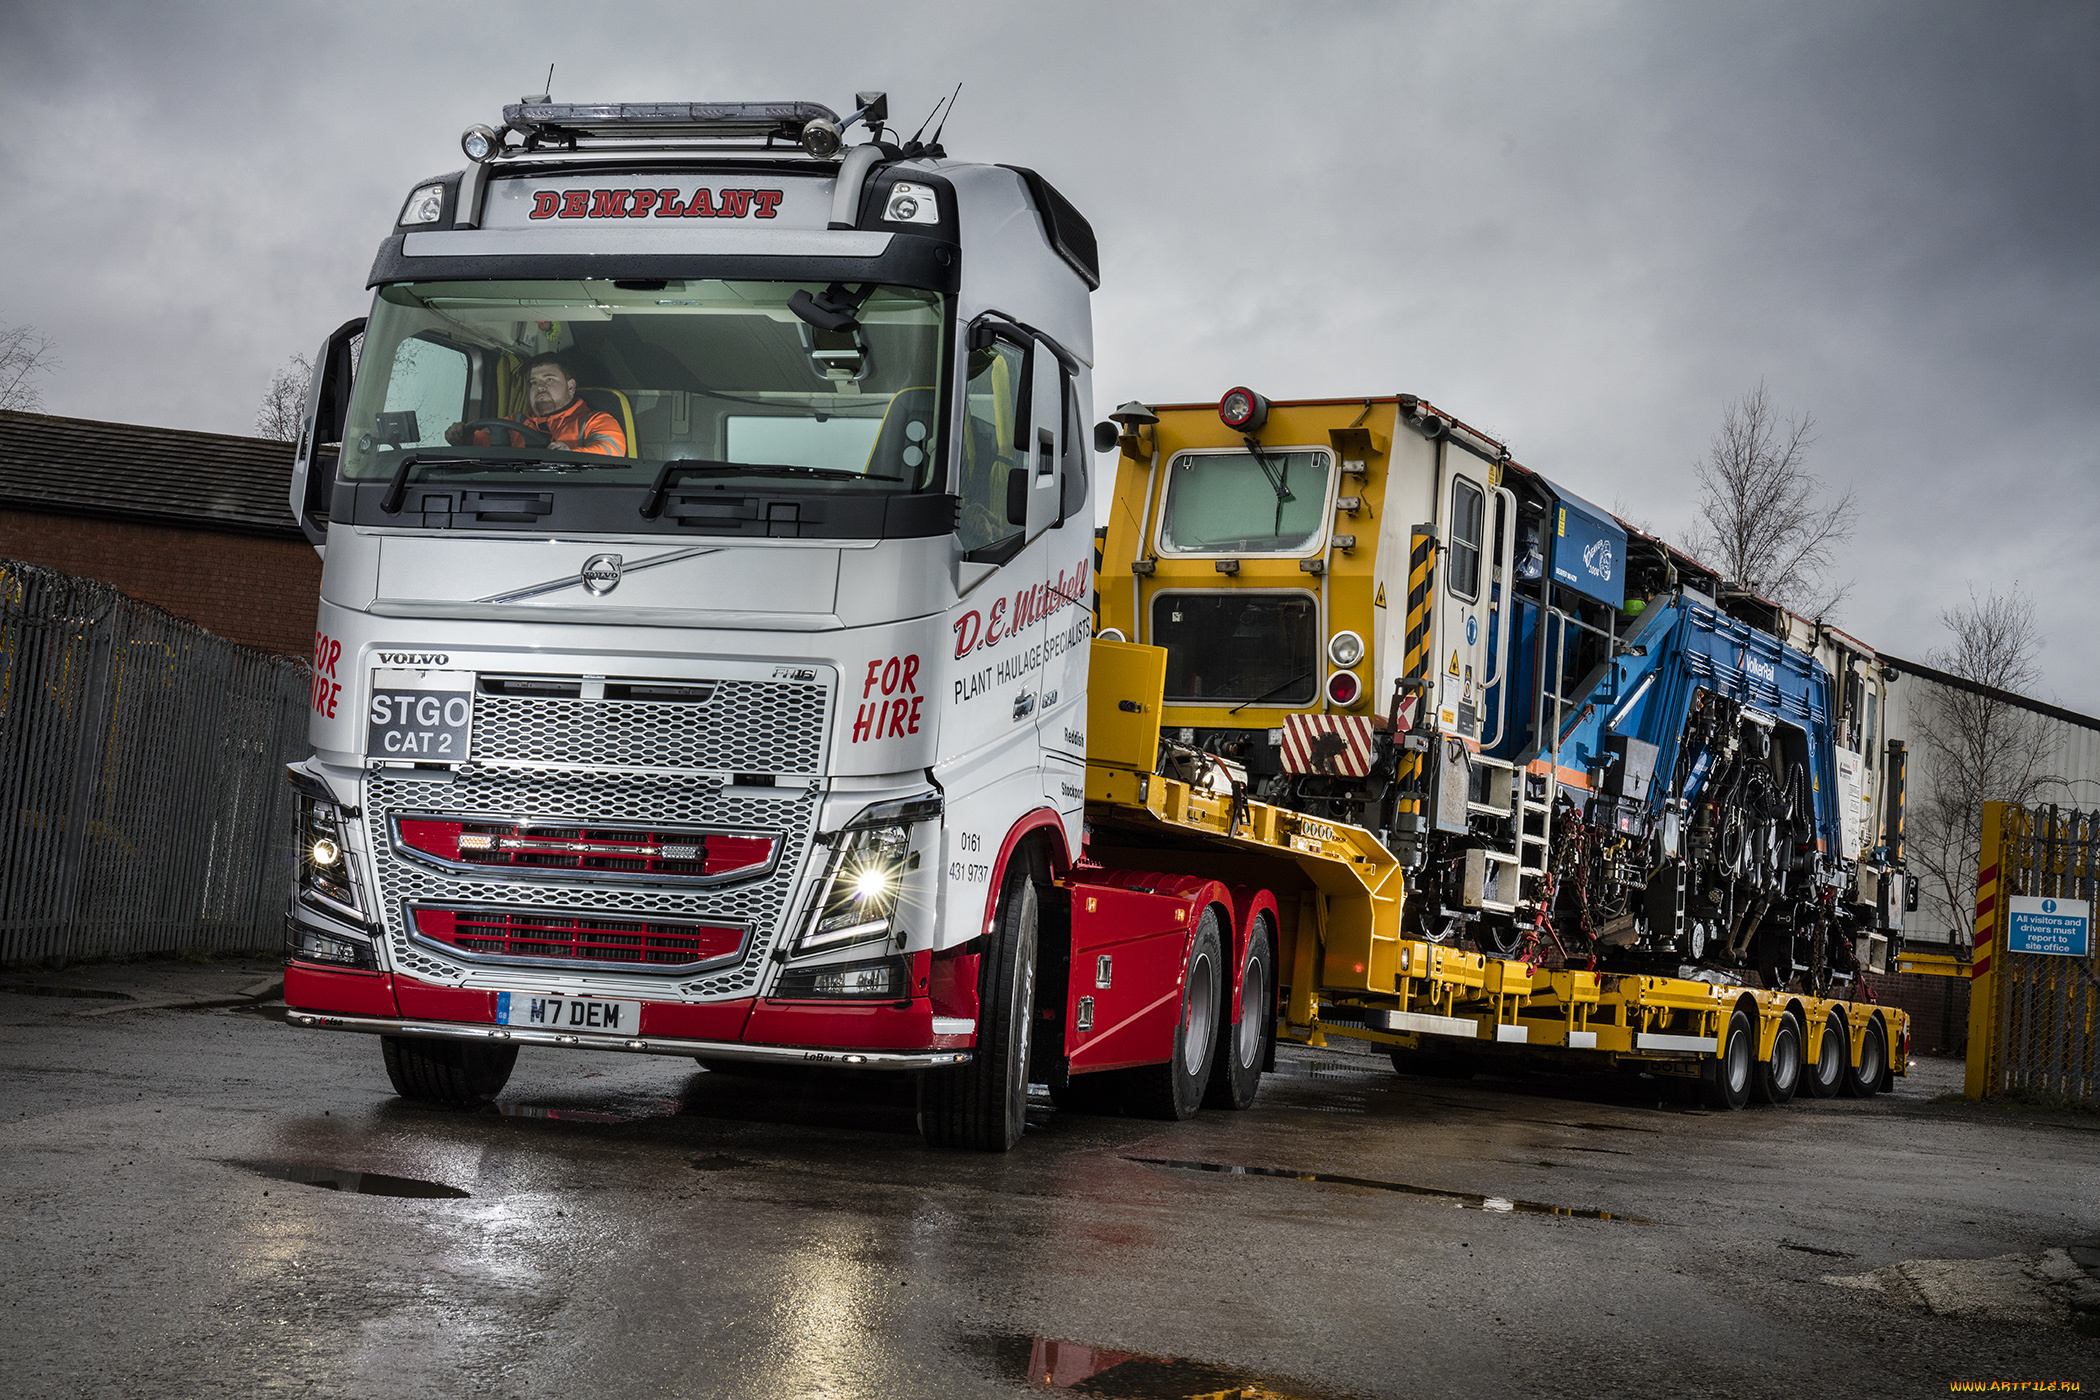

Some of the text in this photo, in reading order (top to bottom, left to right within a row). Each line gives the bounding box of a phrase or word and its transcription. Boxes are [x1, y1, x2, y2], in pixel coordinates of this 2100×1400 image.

[529, 188, 784, 220] DEMPLANT
[584, 571, 619, 579] VOLVO
[377, 652, 450, 666] VOLVO
[954, 616, 1090, 705] PLANT HAULAGE SPECIALISTS
[1746, 654, 1775, 682] VolkerRail
[772, 666, 818, 681] FH16
[863, 654, 919, 699] FOR
[370, 694, 469, 727] STGO
[852, 696, 924, 743] HIRE
[384, 730, 452, 753] CAT 2
[1064, 727, 1085, 748] Reddish
[1061, 781, 1084, 800] Stockport
[961, 832, 982, 852] 0161
[949, 862, 989, 883] 431 9737
[2016, 915, 2082, 927] All visitors and
[2020, 924, 2052, 933] drivers
[2025, 942, 2070, 952] site office
[2028, 935, 2056, 943] report
[319, 1017, 344, 1026] Kelsa
[531, 998, 620, 1029] M7 DEM
[803, 1052, 836, 1063] LoBar
